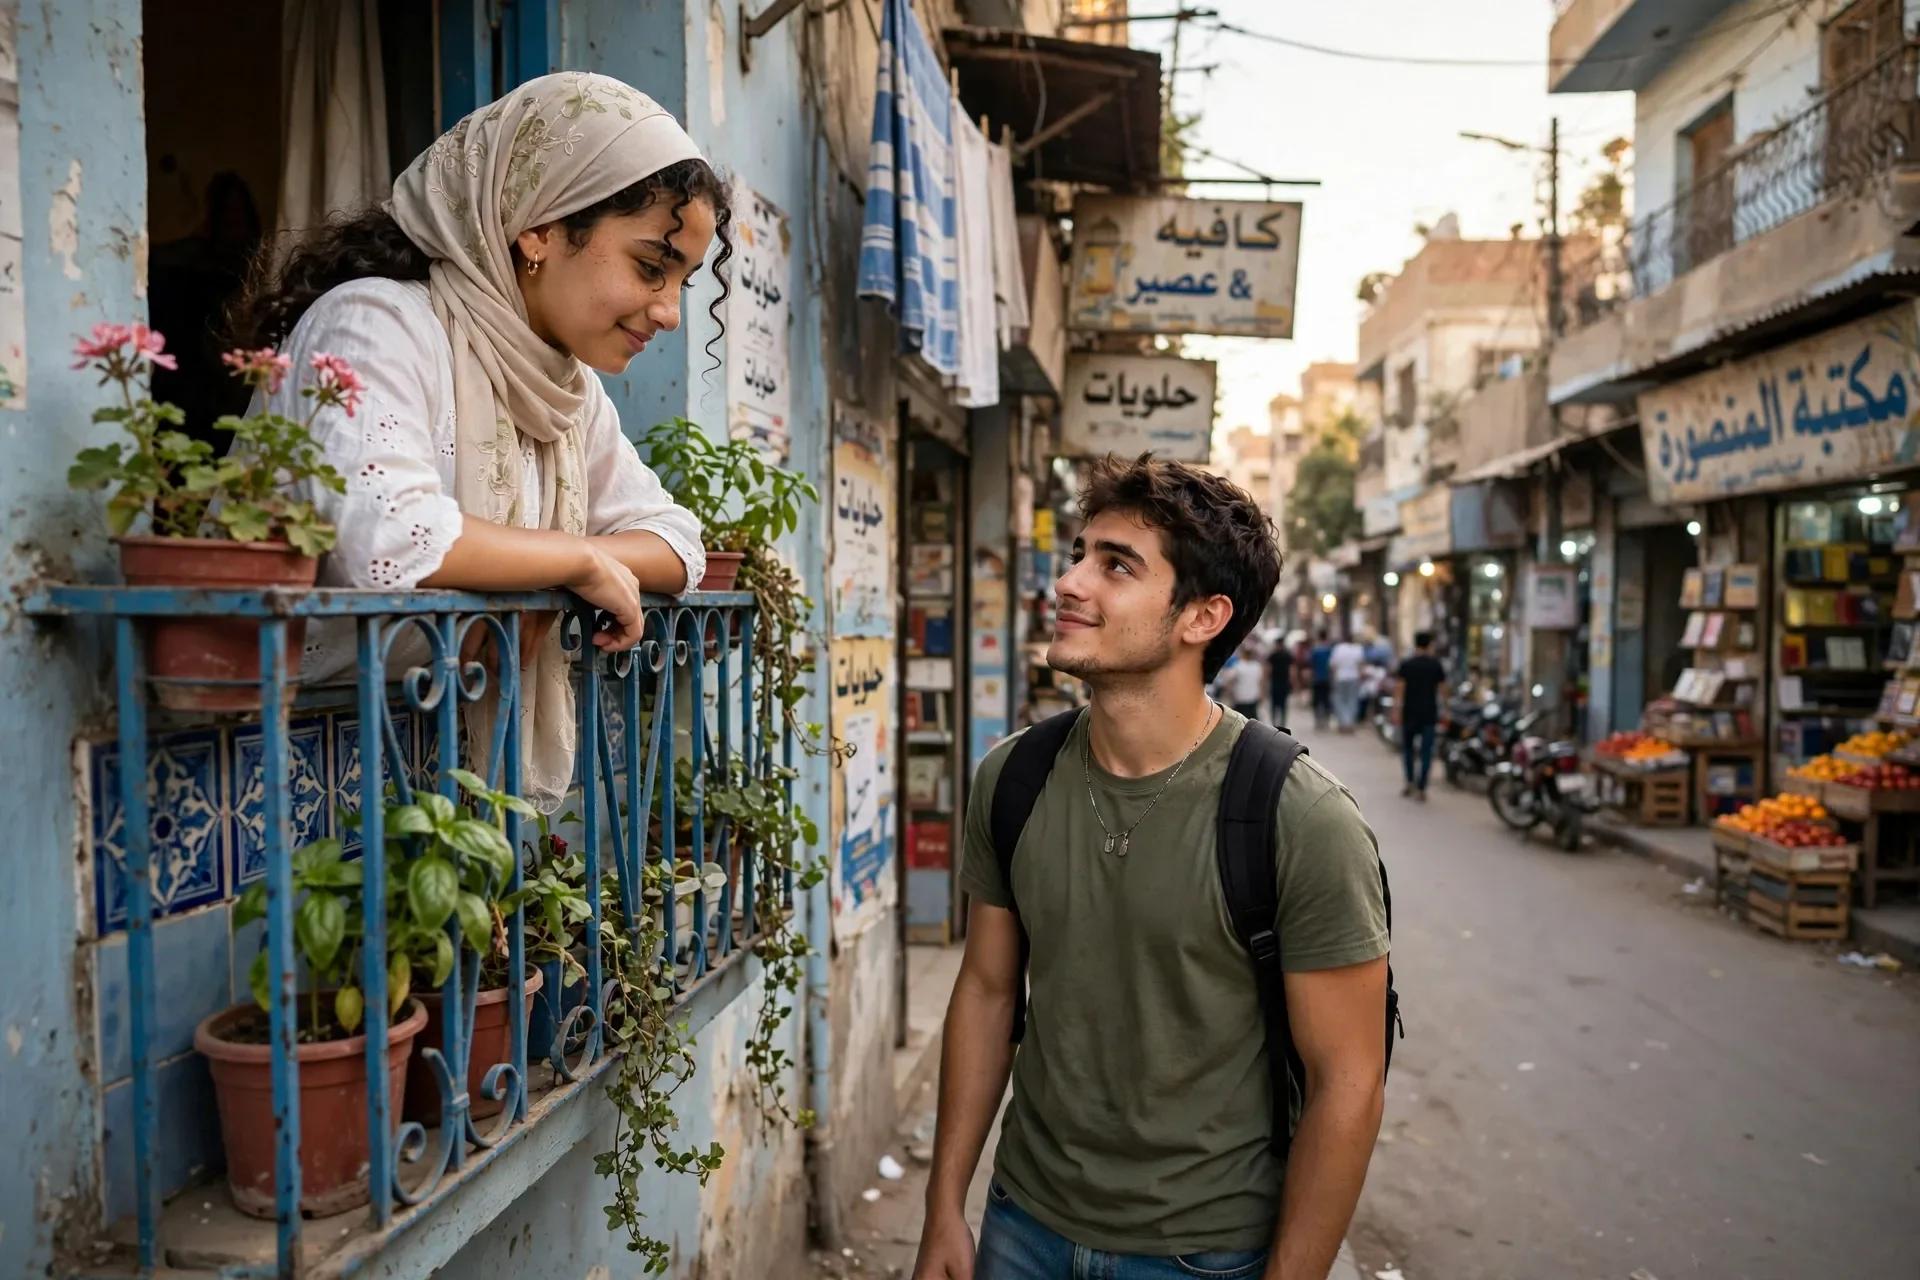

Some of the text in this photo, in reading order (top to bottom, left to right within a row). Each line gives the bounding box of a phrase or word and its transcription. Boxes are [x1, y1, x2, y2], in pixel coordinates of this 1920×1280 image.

[1156, 205, 1283, 259] كافيه
[1125, 268, 1254, 305] & عصير
[1082, 370, 1199, 418] حلويات
[1787, 342, 1908, 456] مكتبة
